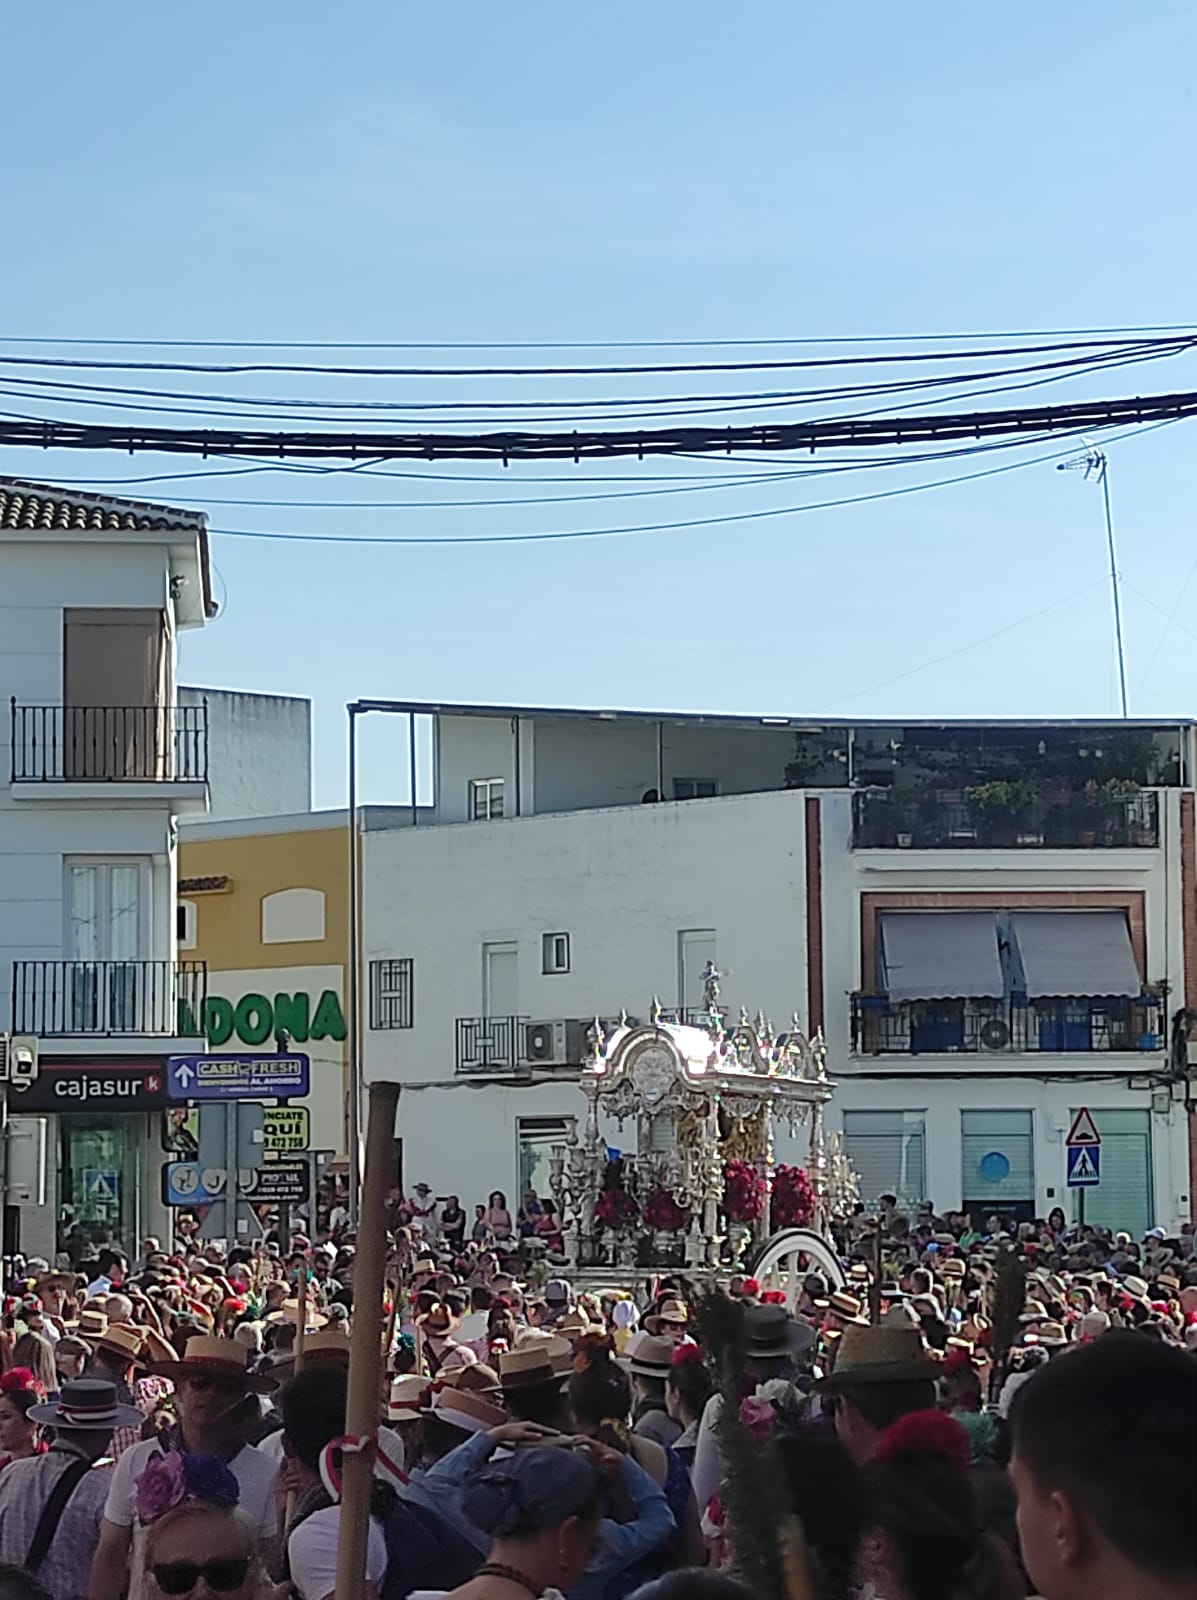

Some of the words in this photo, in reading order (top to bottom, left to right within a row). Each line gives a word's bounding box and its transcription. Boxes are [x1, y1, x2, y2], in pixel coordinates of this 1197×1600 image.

[200, 1064, 238, 1074] CASH
[251, 1062, 298, 1073] FRESH
[55, 1075, 142, 1100] cajasur
